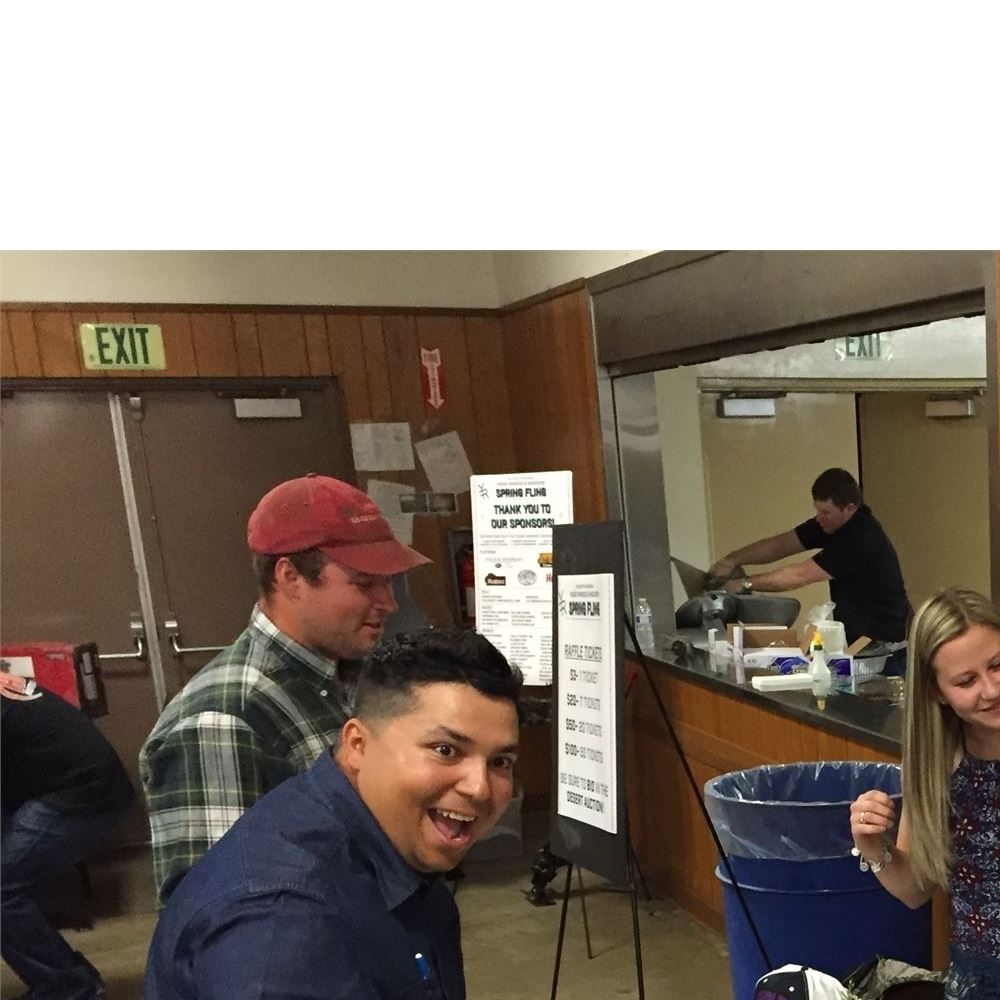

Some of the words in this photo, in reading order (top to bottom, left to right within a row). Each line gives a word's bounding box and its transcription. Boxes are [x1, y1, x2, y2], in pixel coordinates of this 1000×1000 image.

[95, 327, 150, 364] EXIT
[496, 488, 523, 498] SPRING
[525, 487, 547, 497] FLING
[493, 504, 521, 515] THANK
[523, 504, 539, 514] YOU
[540, 504, 551, 514] TO
[491, 519, 508, 529] OUR
[510, 518, 554, 529] SPONSORS!
